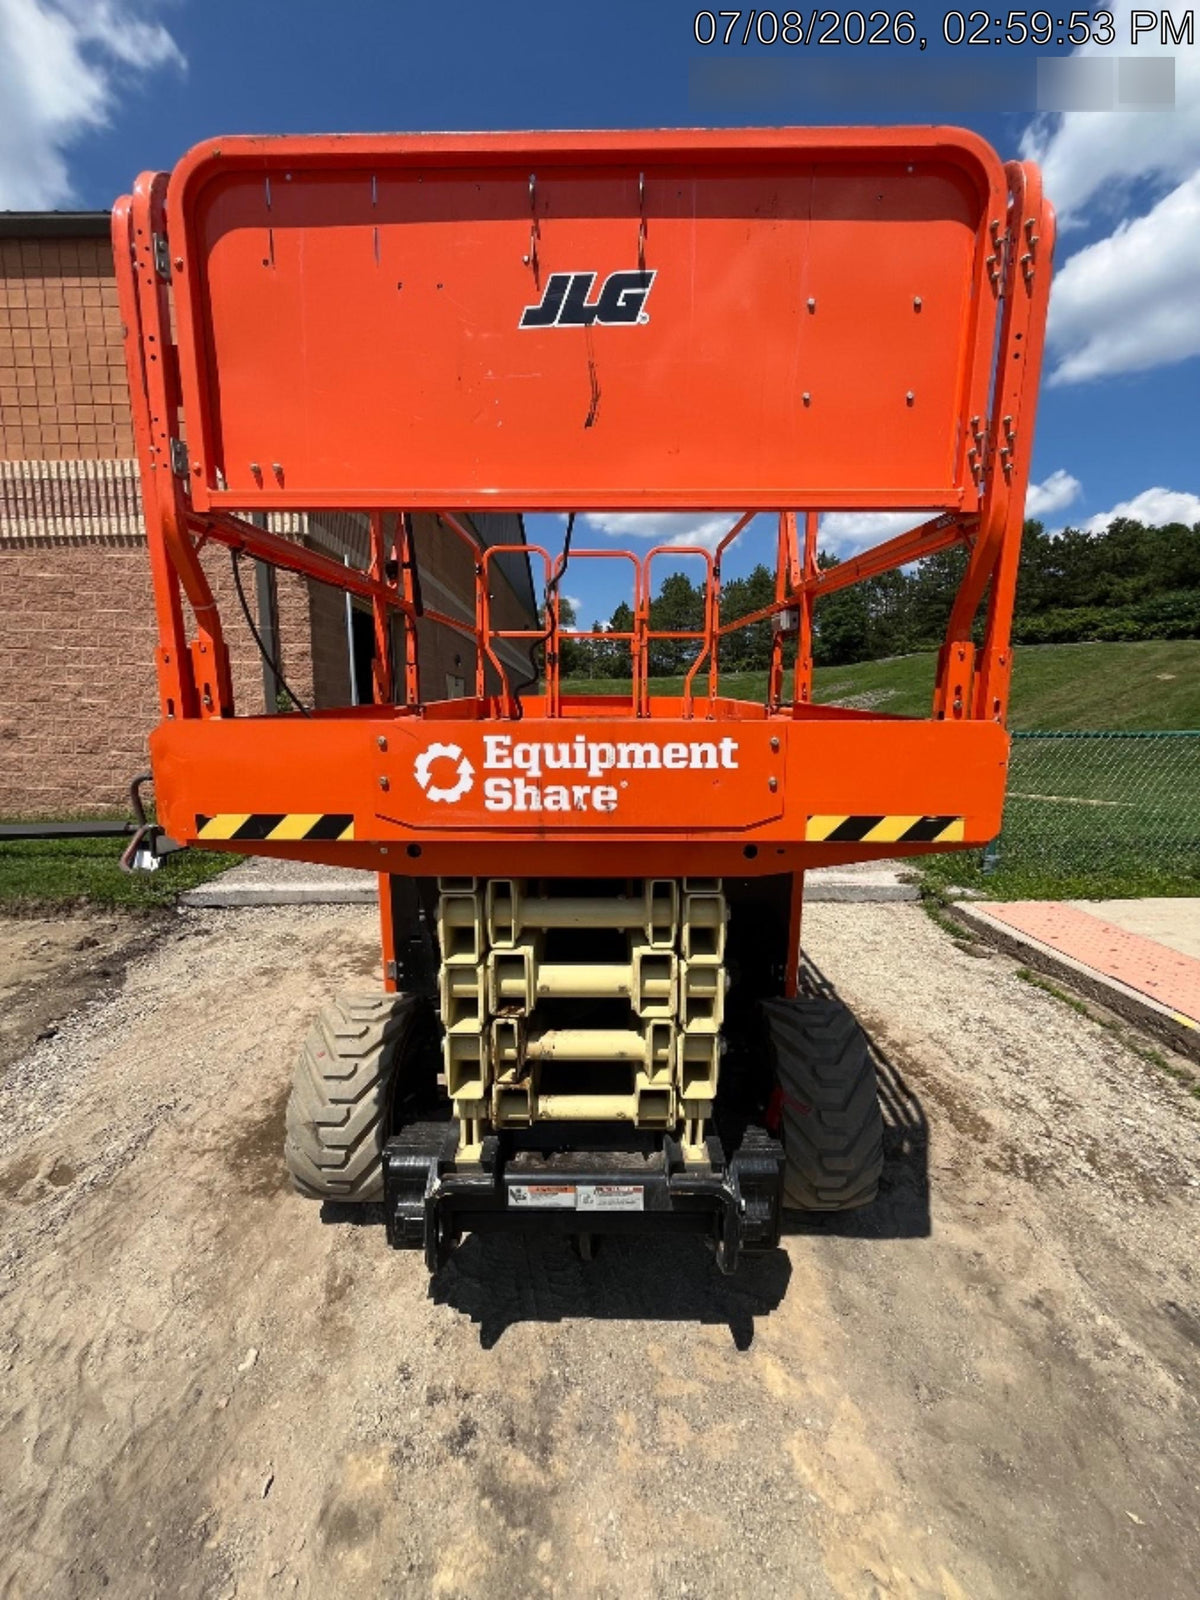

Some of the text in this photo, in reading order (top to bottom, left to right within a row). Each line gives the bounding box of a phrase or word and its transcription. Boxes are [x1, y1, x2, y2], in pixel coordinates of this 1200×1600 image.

[518, 270, 657, 330] JLG
[483, 735, 739, 778] Equipment
[483, 777, 618, 812] Share
